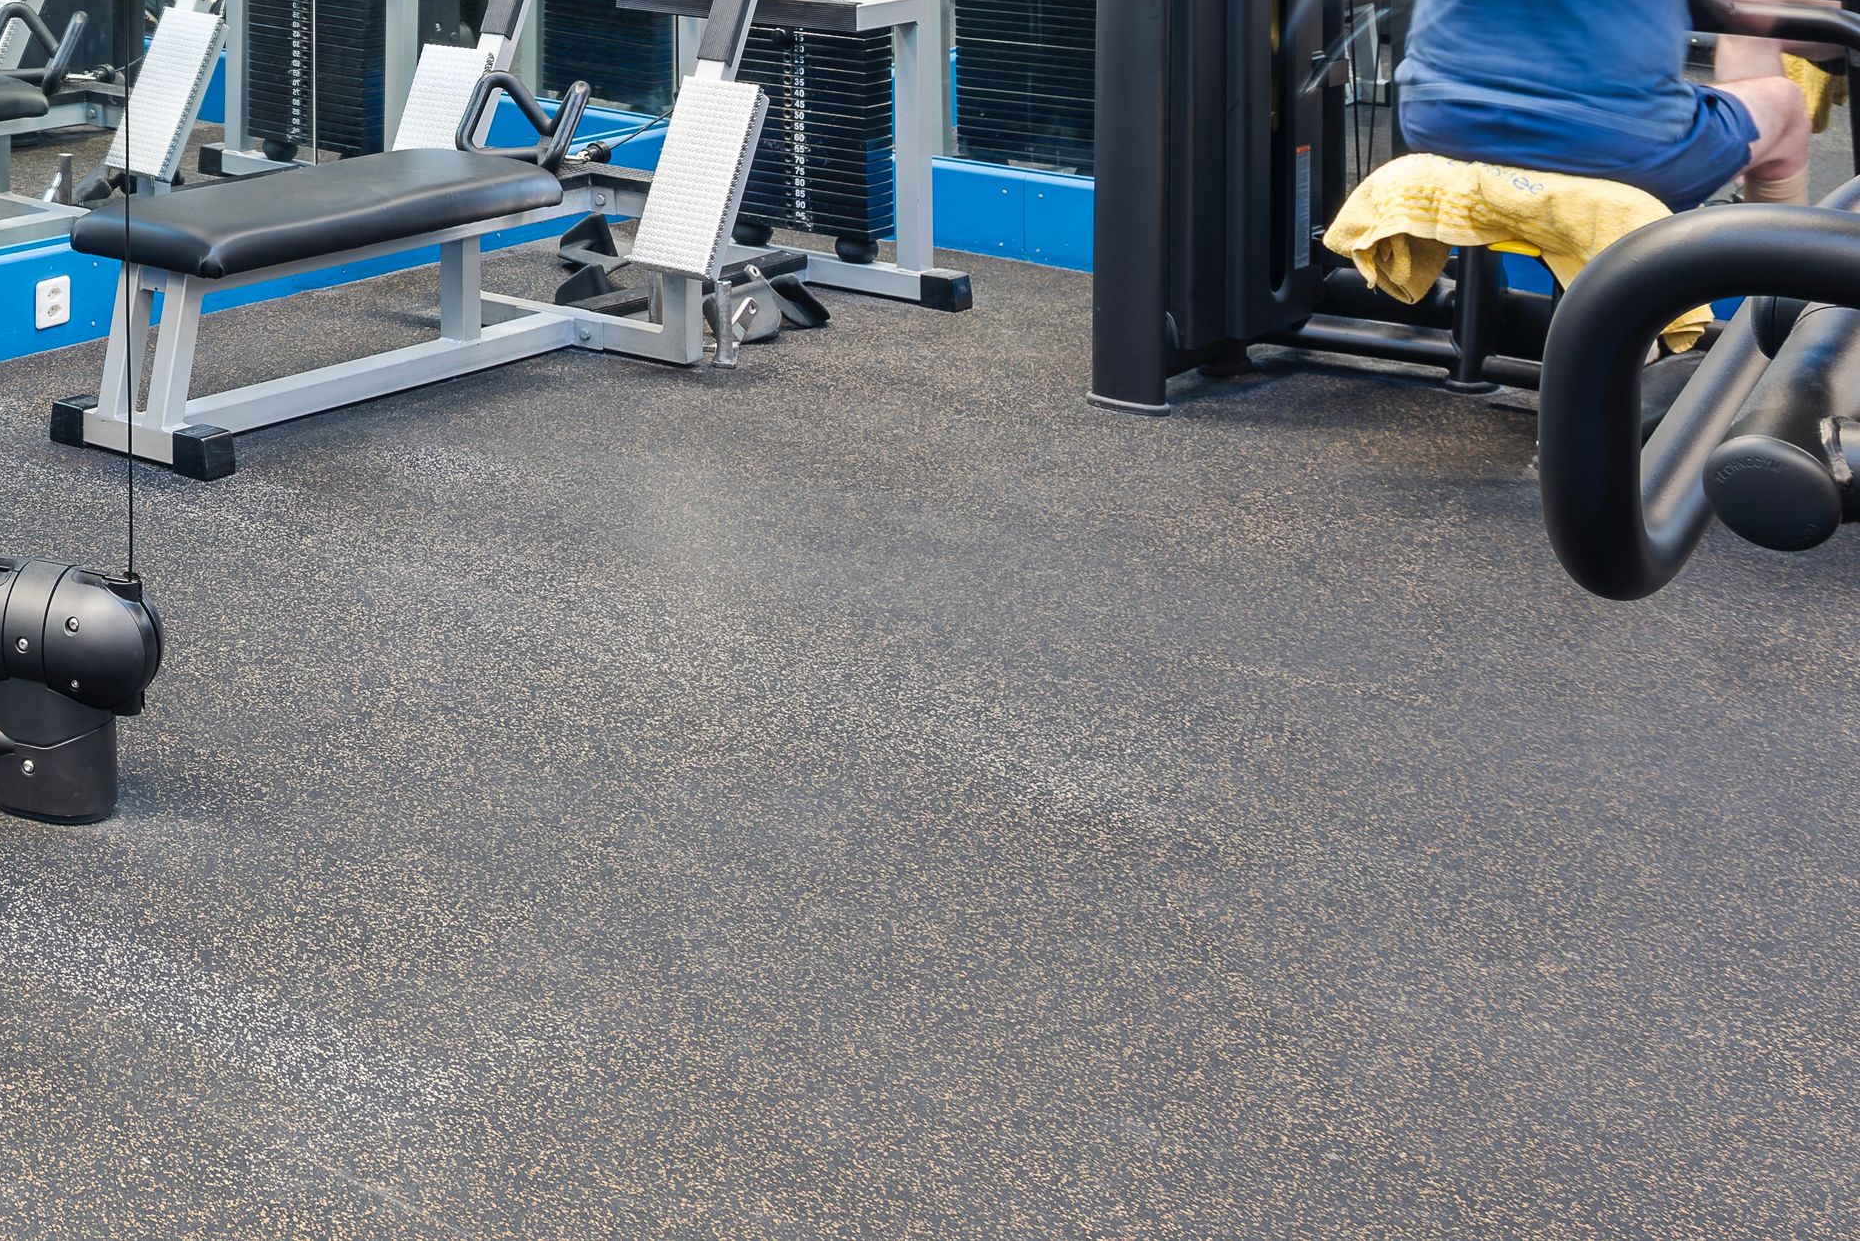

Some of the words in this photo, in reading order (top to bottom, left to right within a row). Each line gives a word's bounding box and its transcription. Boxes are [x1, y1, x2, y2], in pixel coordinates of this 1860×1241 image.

[794, 78, 805, 86] 35
[794, 89, 805, 97] 40
[794, 100, 805, 108] 45
[793, 111, 805, 120] 50
[793, 122, 805, 131] 55
[793, 133, 805, 142] 60
[794, 155, 805, 164] 70
[794, 166, 805, 175] 75
[794, 177, 805, 187] 80
[794, 189, 806, 198] 85
[795, 200, 806, 209] 90
